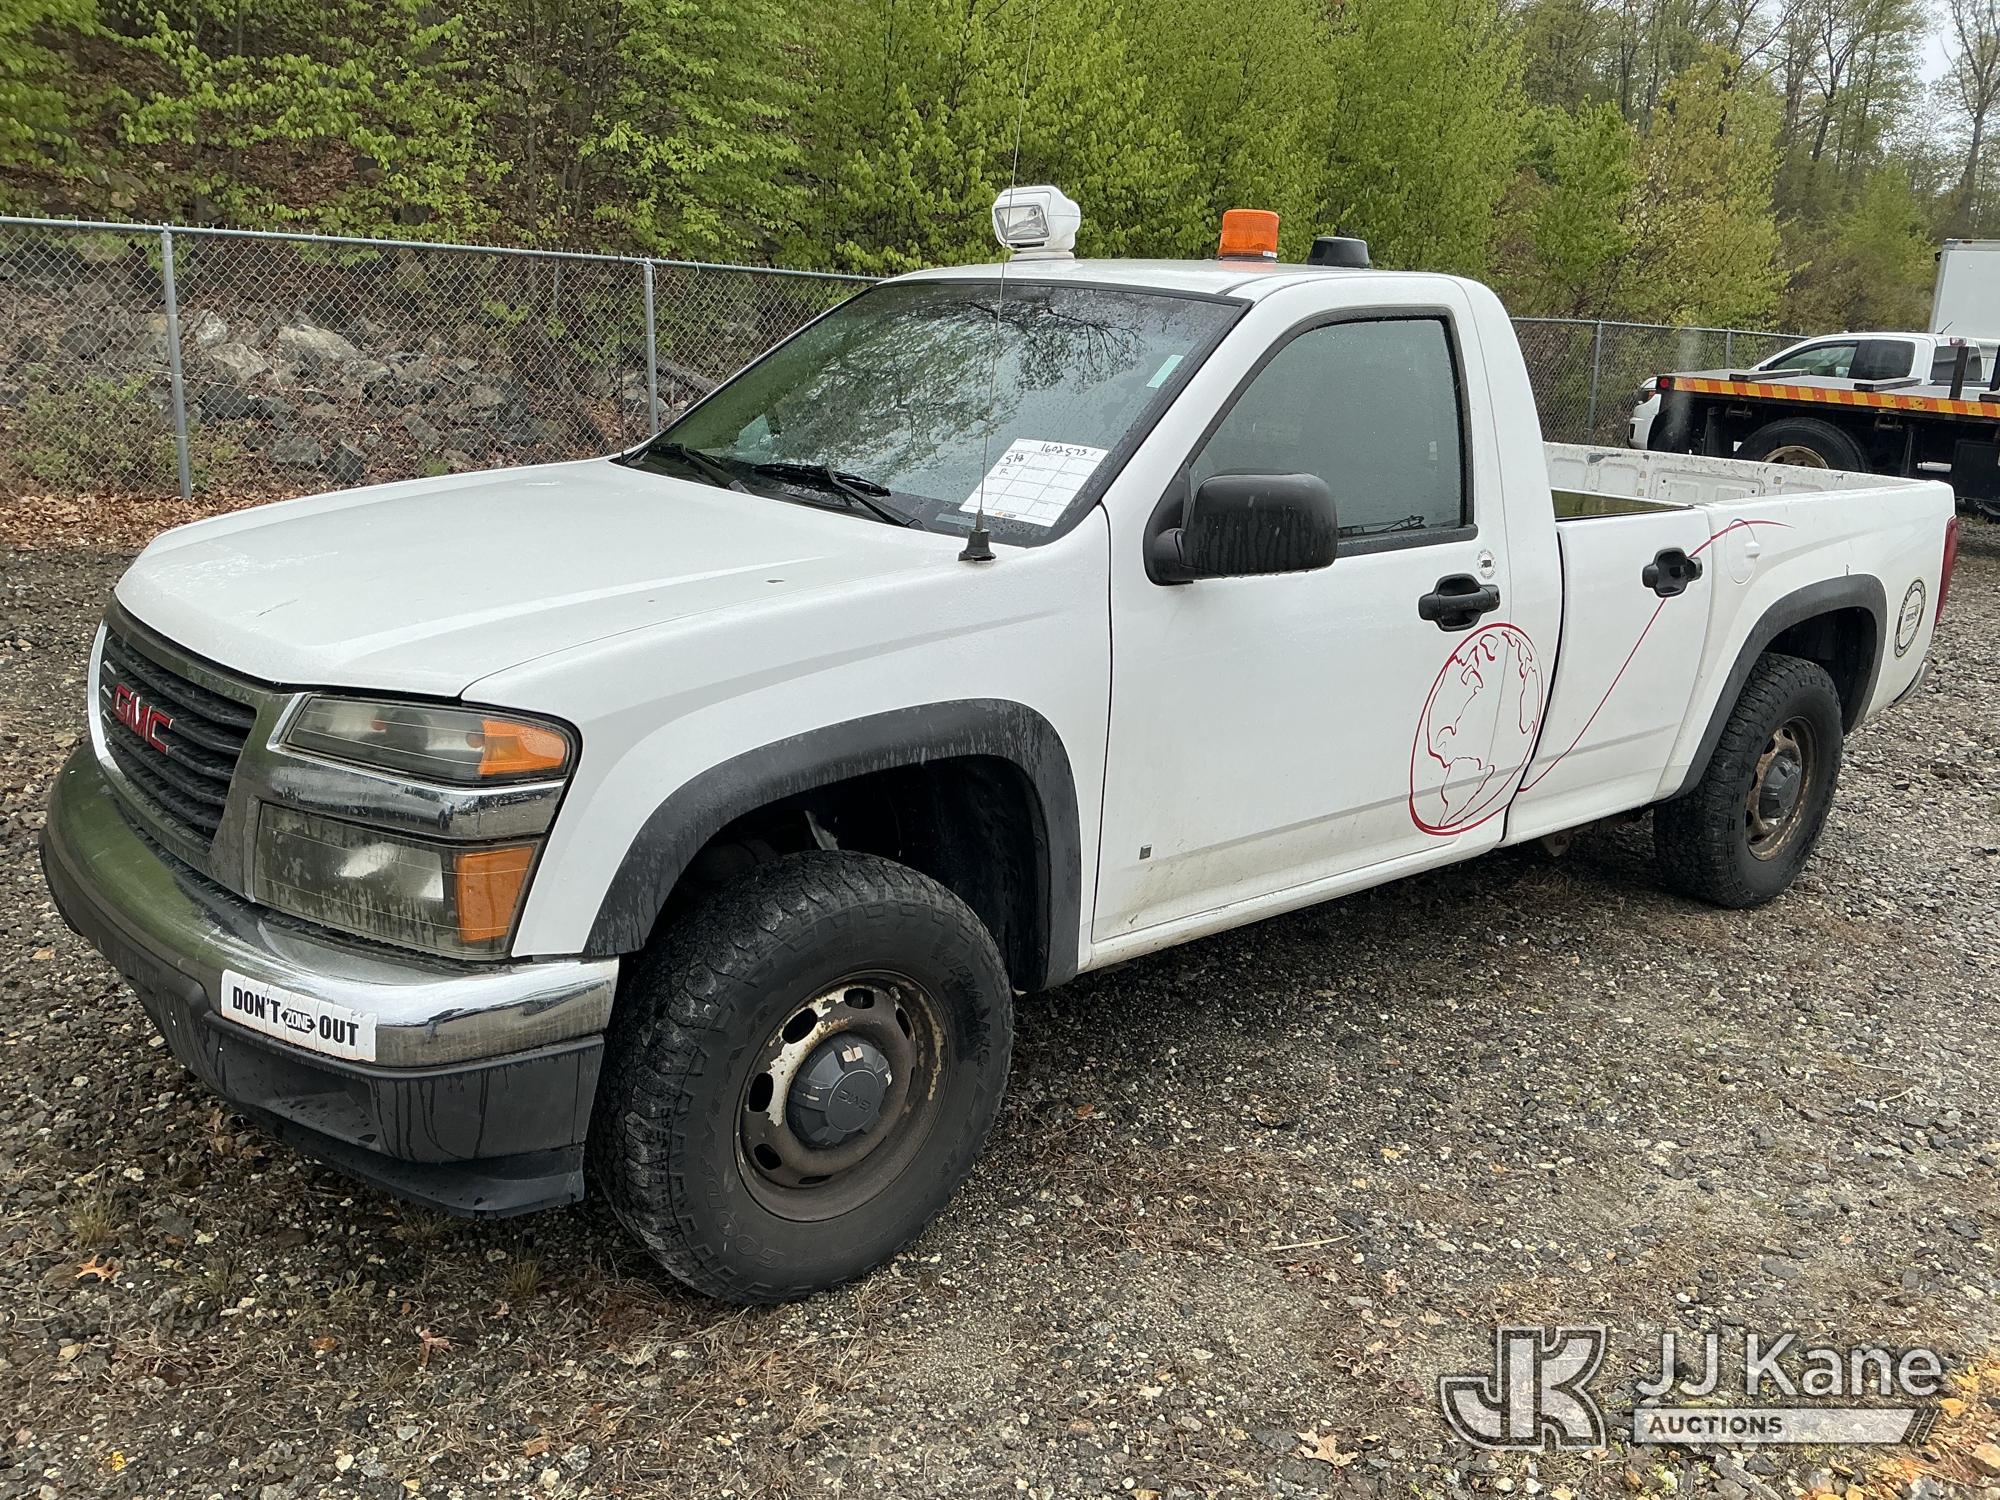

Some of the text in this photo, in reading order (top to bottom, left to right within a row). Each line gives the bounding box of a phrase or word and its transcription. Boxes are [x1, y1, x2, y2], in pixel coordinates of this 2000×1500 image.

[112, 682, 174, 756] GMC
[232, 985, 359, 1047] DON'T ZONE OUT
